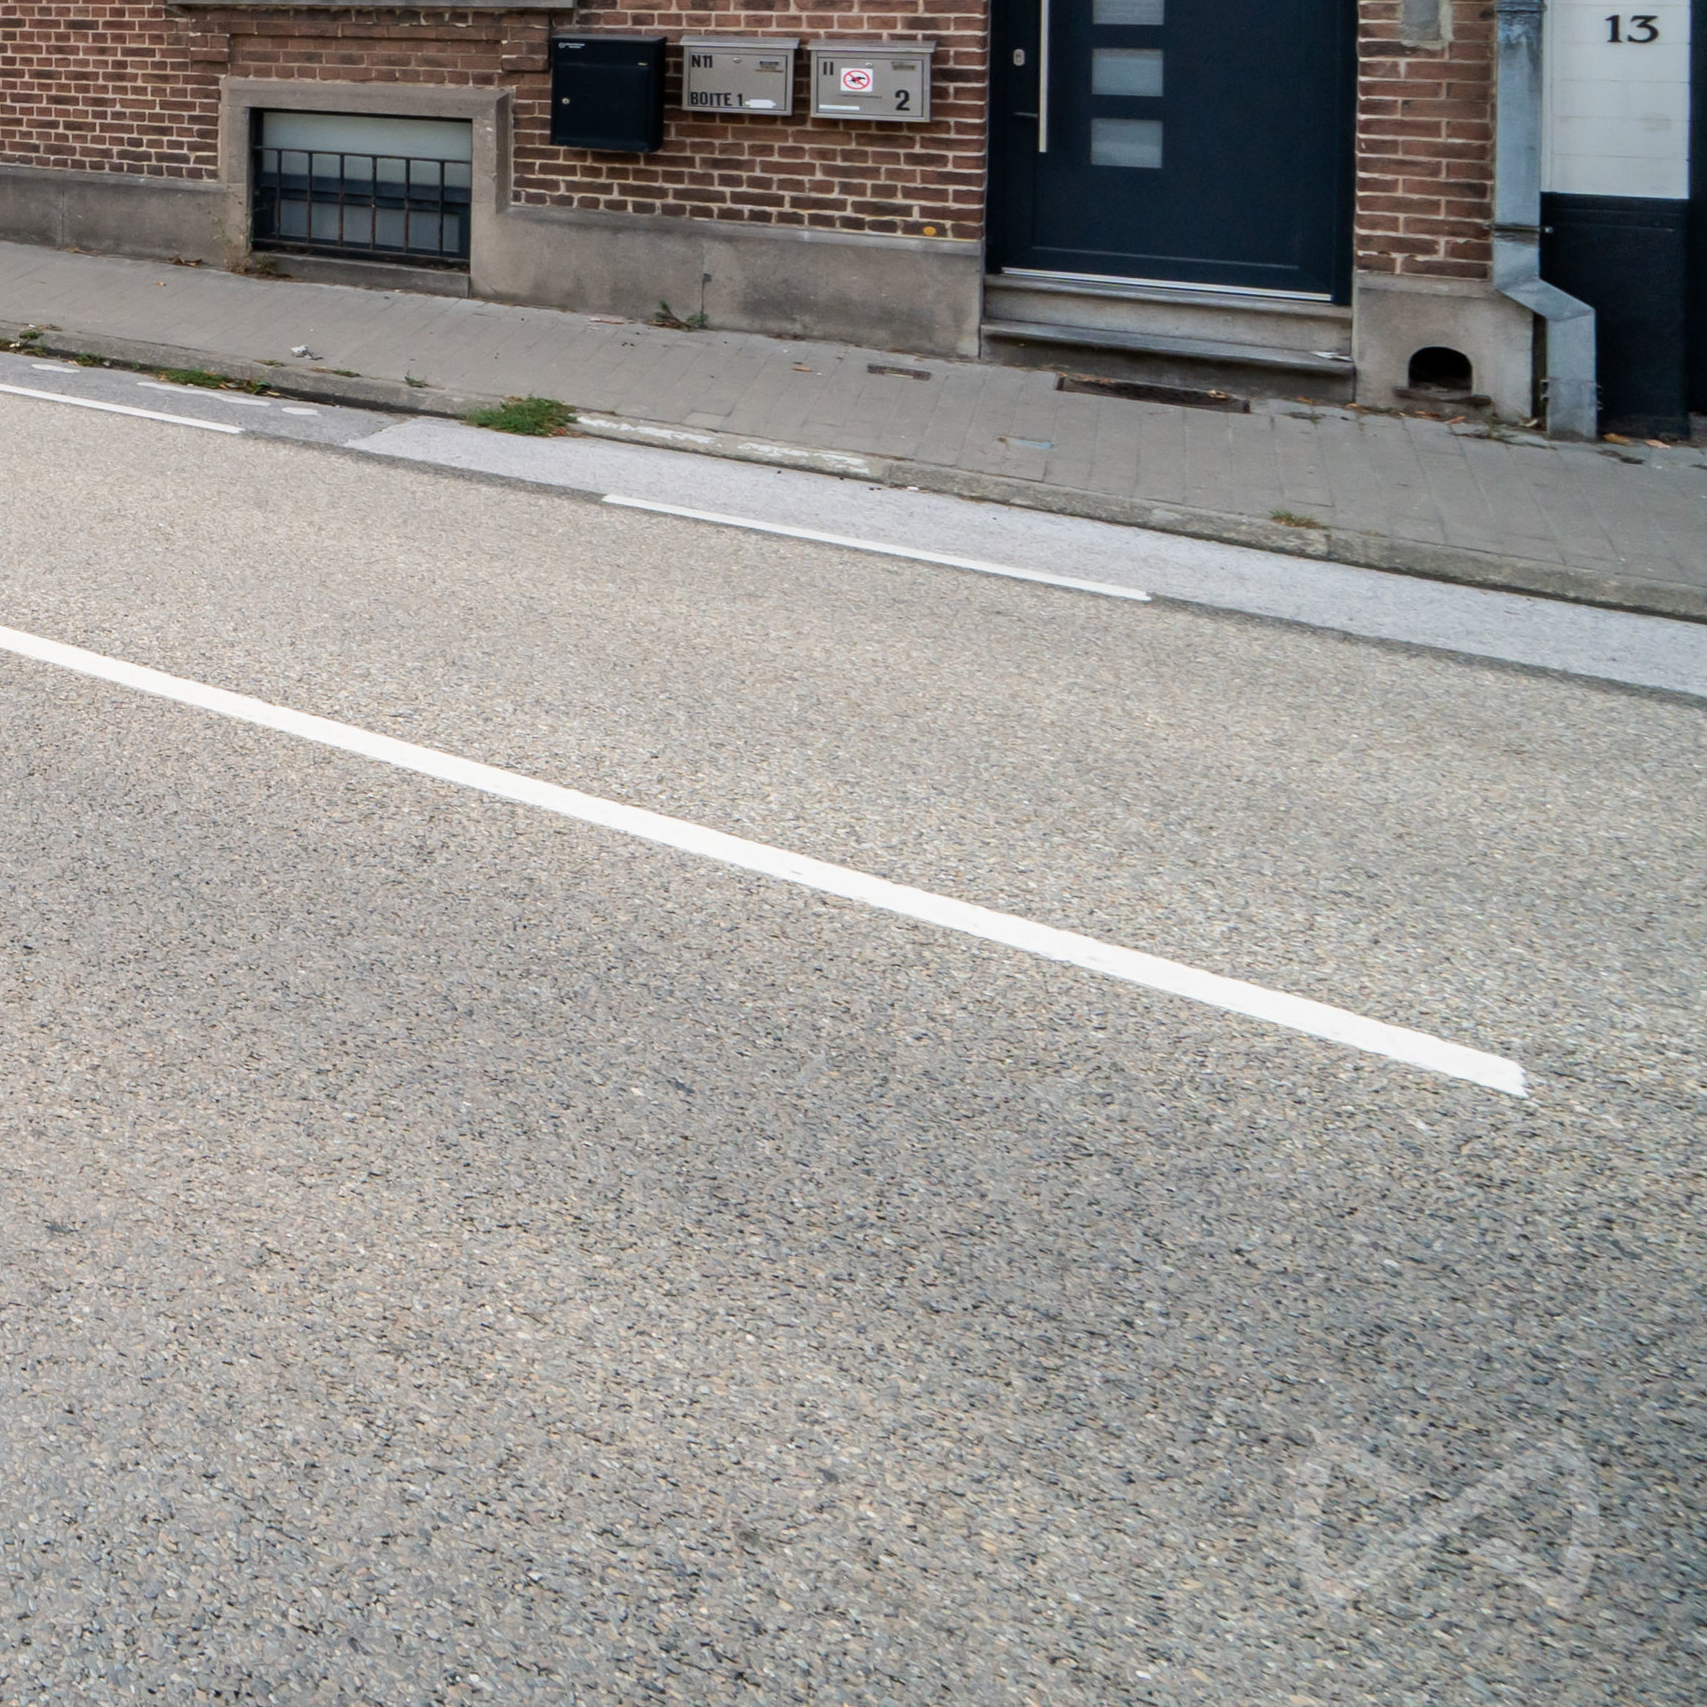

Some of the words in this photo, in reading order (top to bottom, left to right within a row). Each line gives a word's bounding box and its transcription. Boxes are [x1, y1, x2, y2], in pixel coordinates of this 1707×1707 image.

[1605, 15, 1659, 44] 13
[690, 92, 732, 107] BOITE
[737, 94, 743, 107] 1
[894, 89, 911, 112] 2
